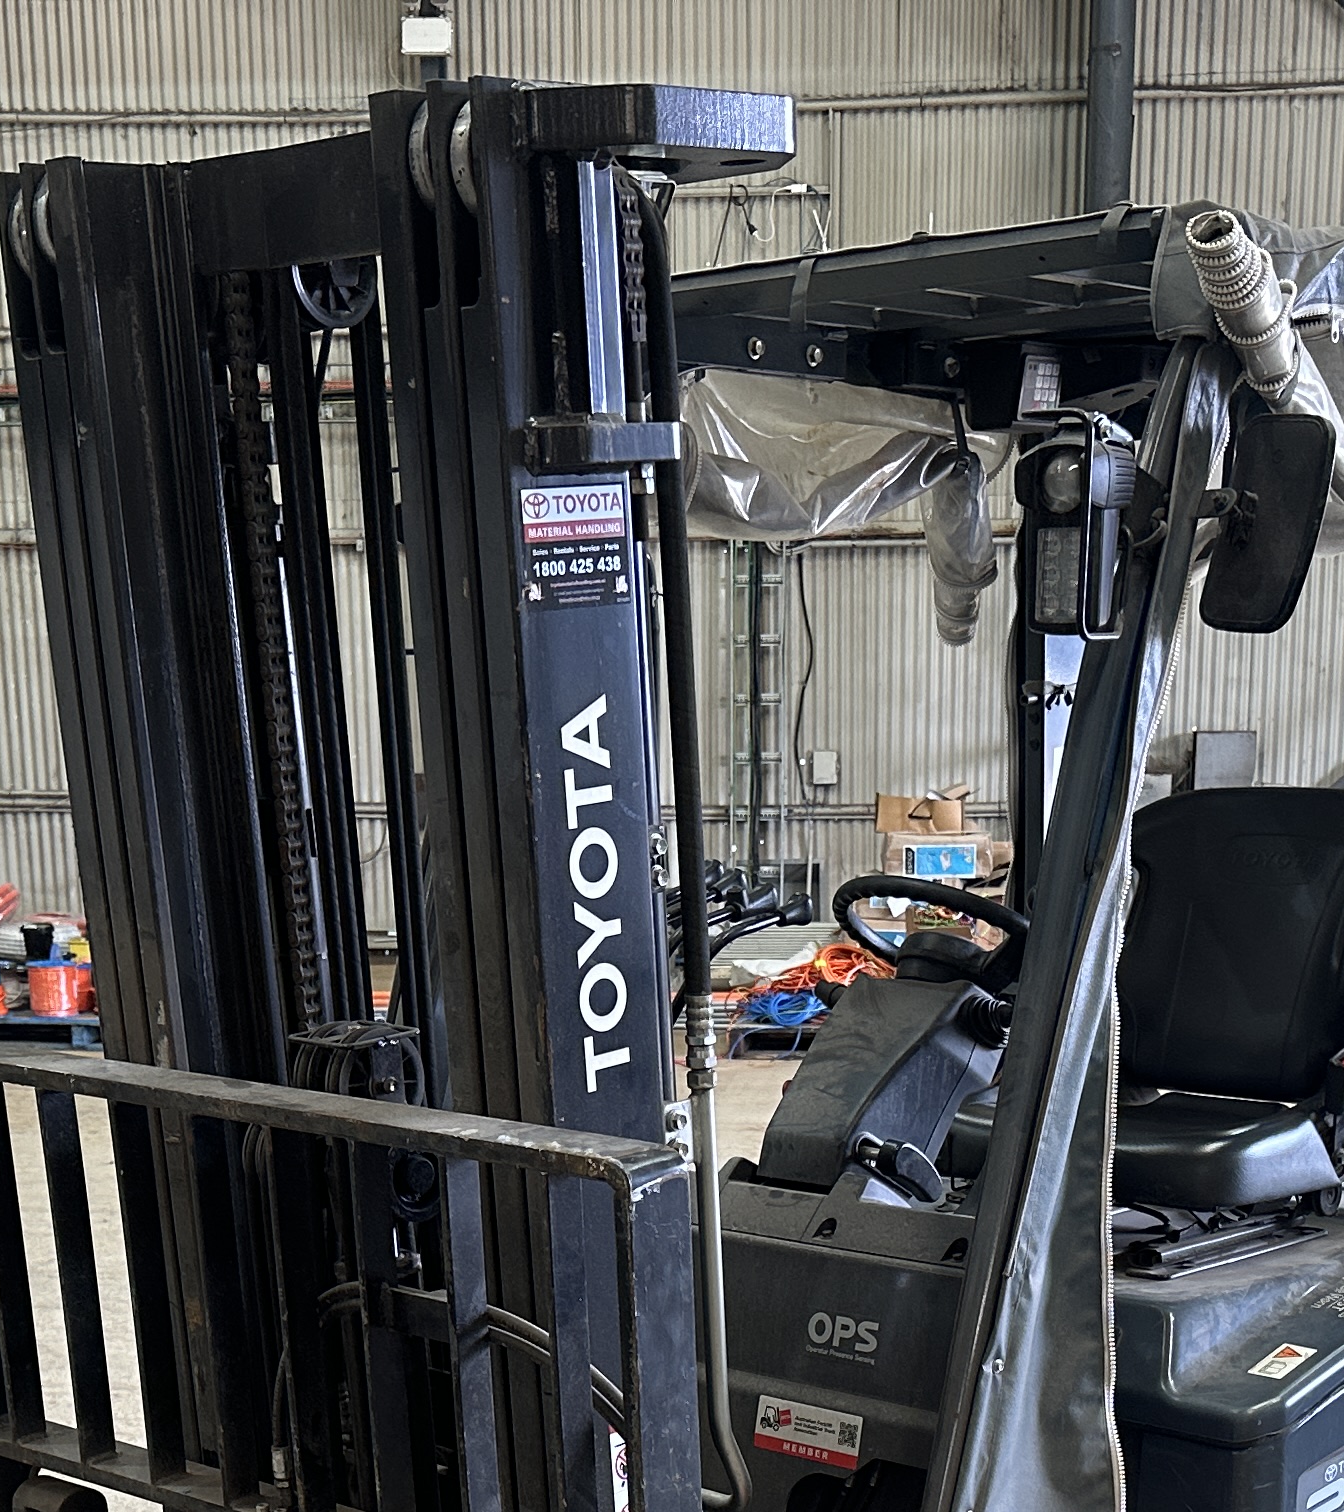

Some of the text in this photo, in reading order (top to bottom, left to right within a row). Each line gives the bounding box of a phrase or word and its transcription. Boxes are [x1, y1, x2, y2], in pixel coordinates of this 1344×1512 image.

[552, 492, 622, 514] TOYOTA
[528, 522, 621, 539] MATERIAL HANDLING
[579, 545, 600, 554] Service
[532, 556, 621, 578] 1800 425 438
[560, 693, 632, 1094] TOYOTA
[807, 1311, 880, 1353] OPS
[782, 1441, 830, 1460] MEMBER
